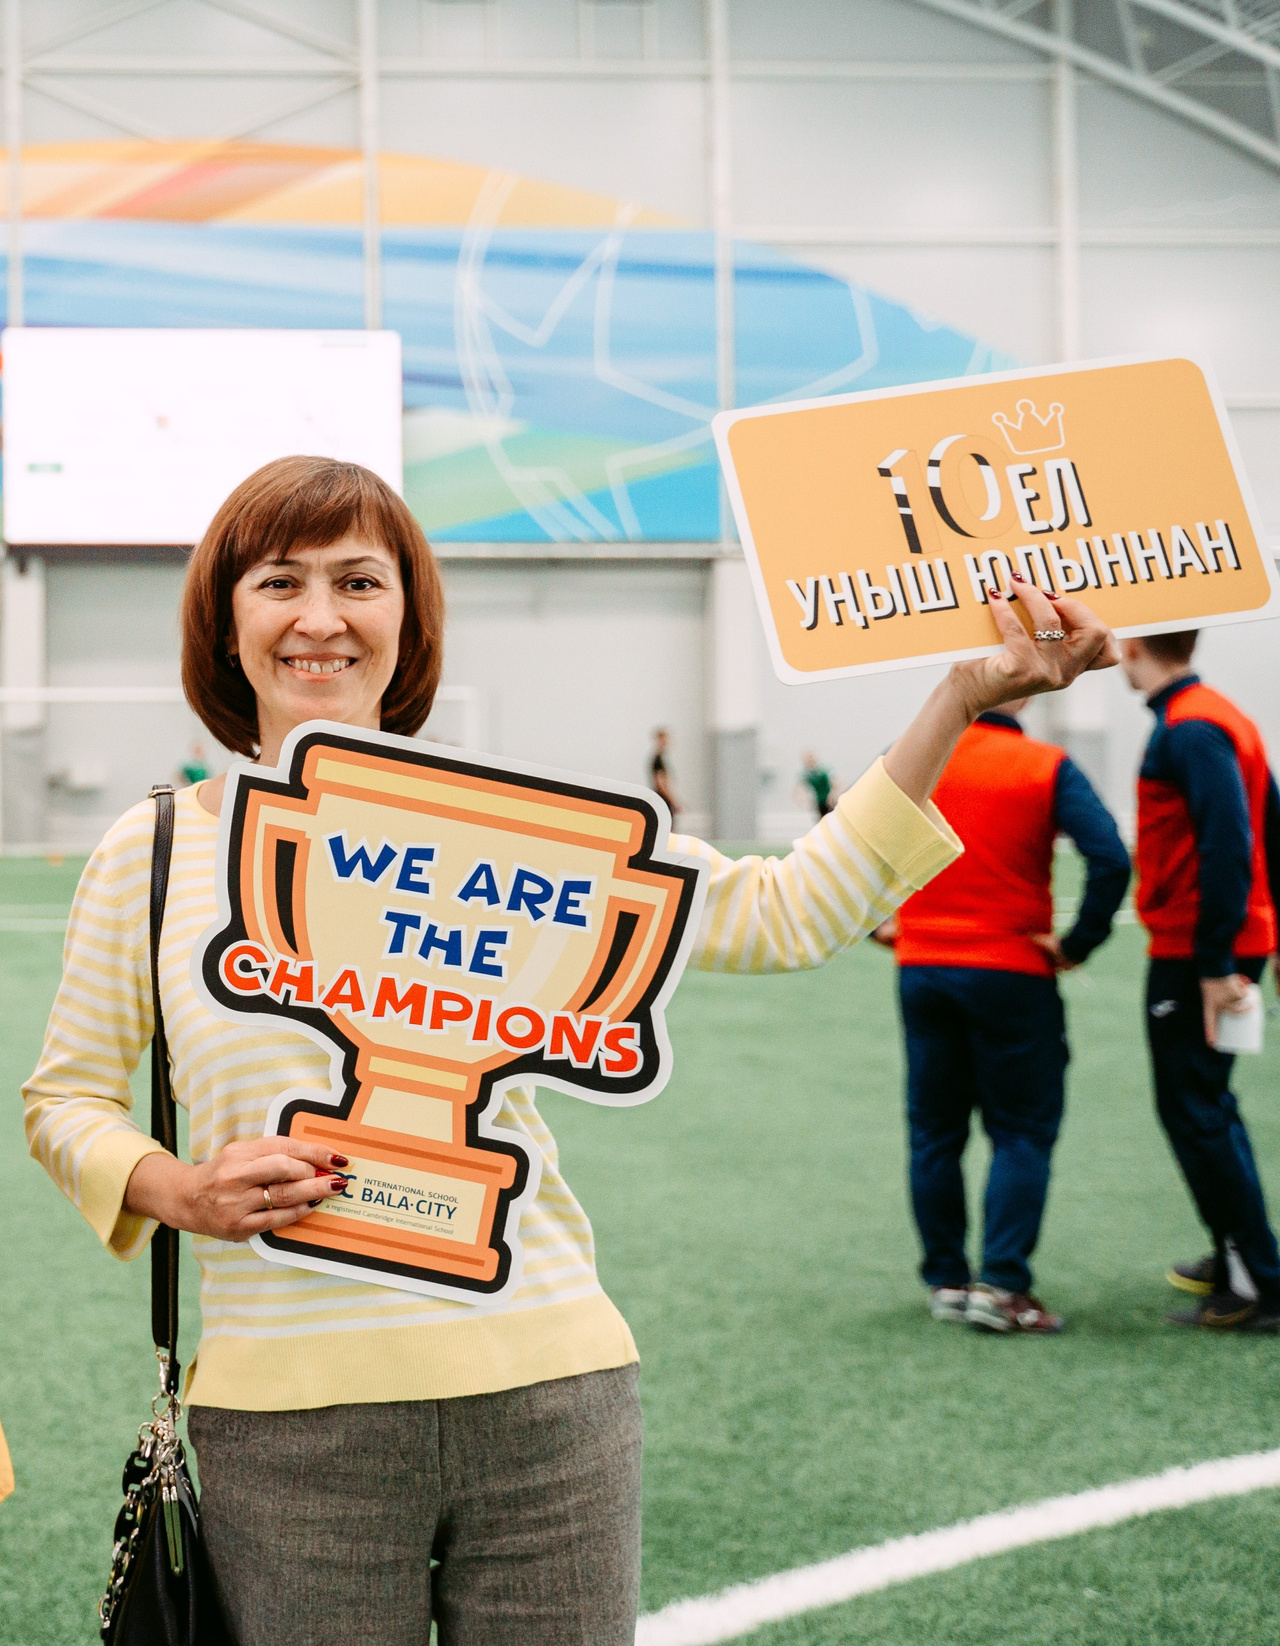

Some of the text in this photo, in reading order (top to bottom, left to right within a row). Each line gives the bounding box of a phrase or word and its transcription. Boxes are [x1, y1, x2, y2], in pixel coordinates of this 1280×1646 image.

[876, 434, 1093, 554] 10 ЕЛ
[785, 558, 959, 631] УҢЫШ
[325, 832, 593, 928] WE ARE
[383, 910, 509, 979] THE
[222, 943, 640, 1073] CHAMPIONS
[331, 1205, 362, 1215] registered
[362, 1210, 395, 1223] Cambridge
[434, 1225, 454, 1235] School
[363, 1178, 459, 1204] INTERNATIONAL SCHOOL
